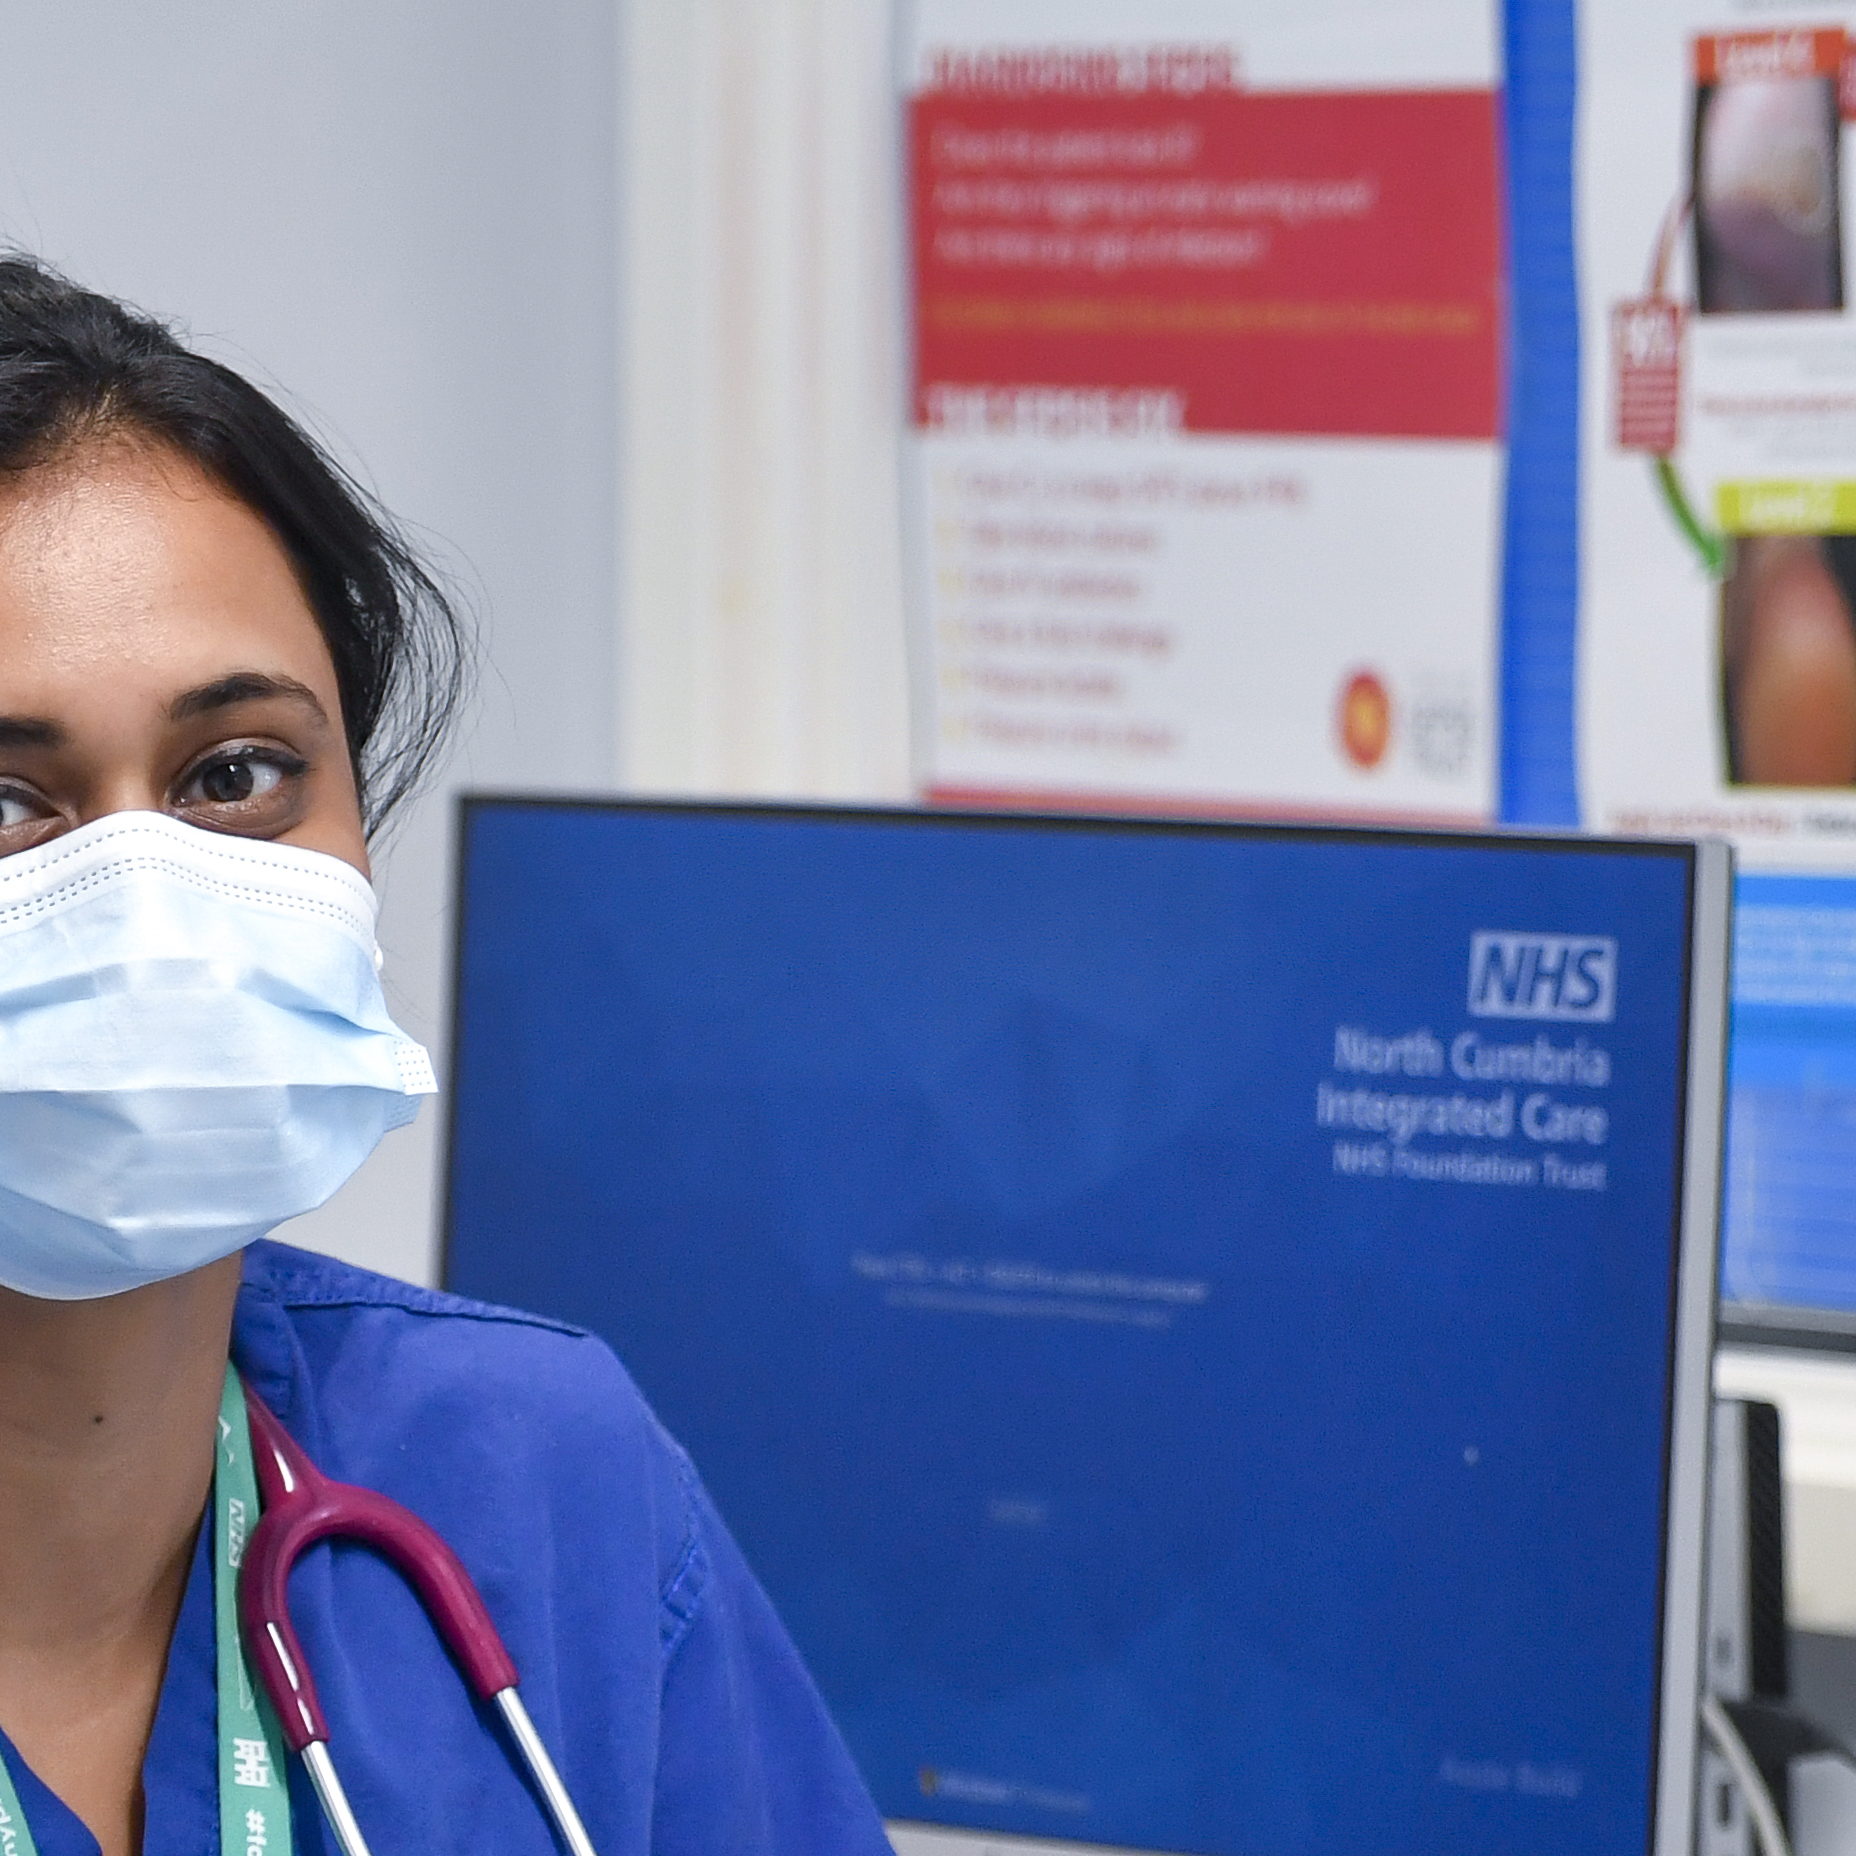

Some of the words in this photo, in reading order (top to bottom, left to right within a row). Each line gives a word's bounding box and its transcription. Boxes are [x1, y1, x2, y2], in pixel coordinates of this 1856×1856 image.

[1472, 941, 1608, 1014] NHS
[1334, 1025, 1444, 1077] North
[1450, 1030, 1612, 1088] Cumbria
[1316, 1081, 1515, 1144] Integrated
[1520, 1093, 1610, 1145] Care
[1332, 1140, 1390, 1178] NHS
[1393, 1145, 1537, 1186] Foundation
[1543, 1154, 1608, 1192] Trust
